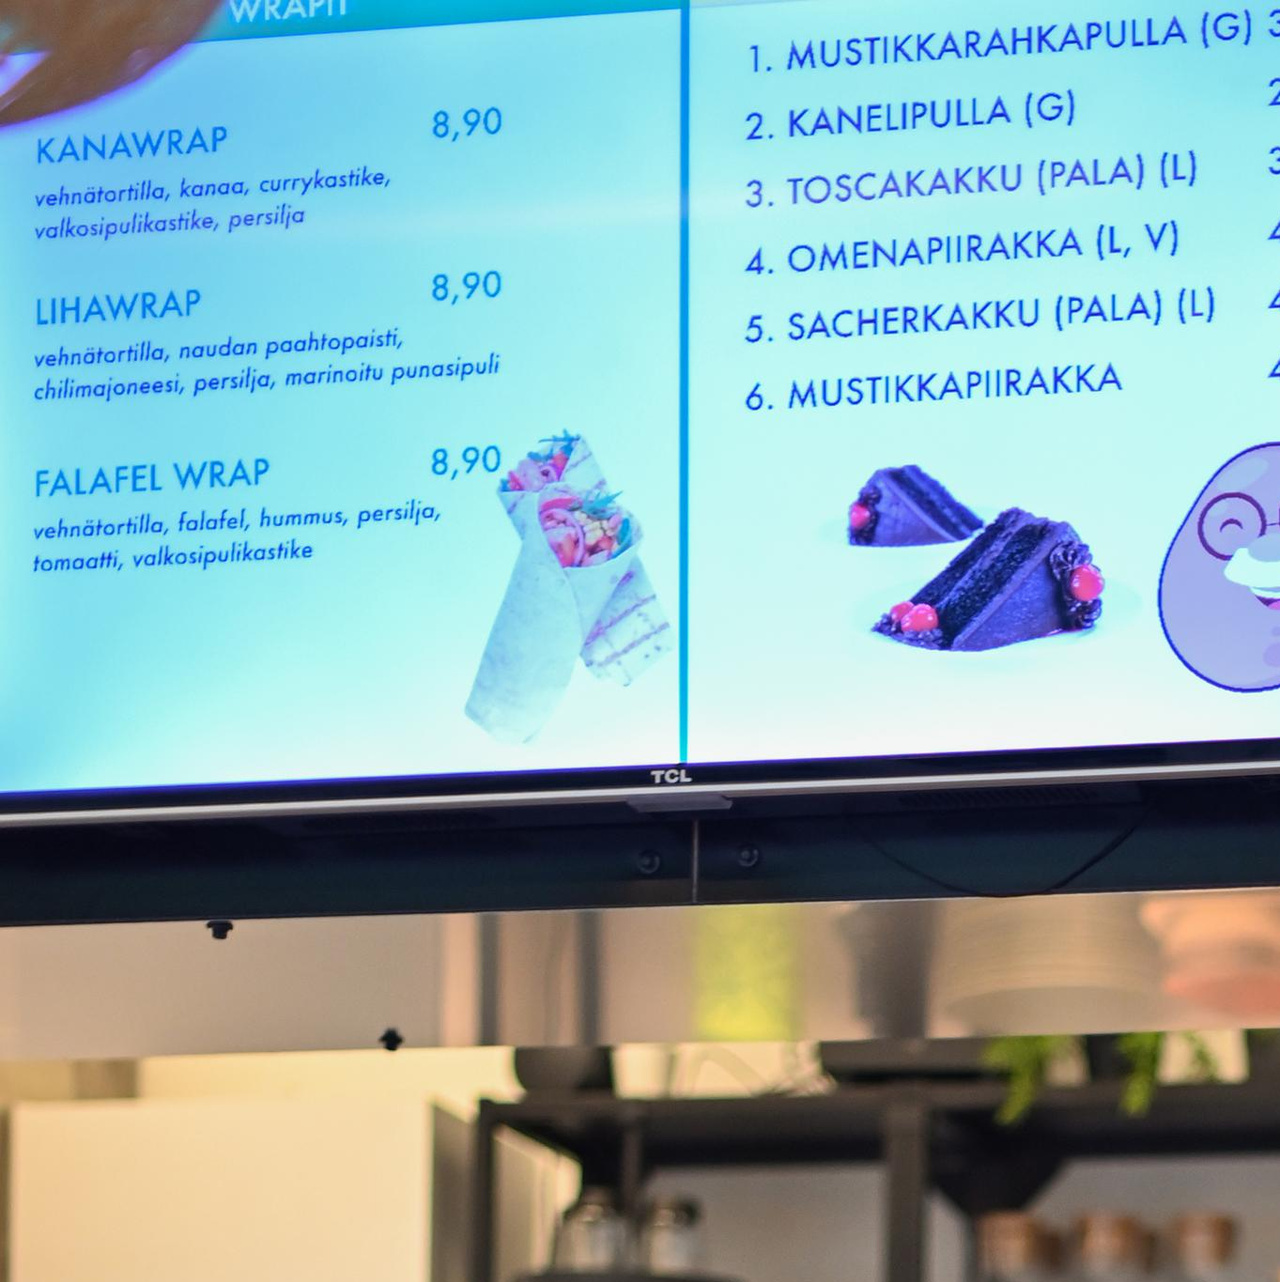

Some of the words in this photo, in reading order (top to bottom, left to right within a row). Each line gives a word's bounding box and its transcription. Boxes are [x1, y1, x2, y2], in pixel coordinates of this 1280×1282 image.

[749, 45, 773, 73] 1.
[786, 15, 1189, 71] MUSTIKKARAHKAPULLA
[1200, 9, 1258, 49] (G)
[431, 105, 504, 143] 8,90
[745, 112, 775, 141] 2.
[788, 95, 1012, 137] KANELIPULLA
[1025, 88, 1076, 129] (G)
[36, 126, 229, 166] KANAWRAP
[35, 179, 171, 208] vehnätortilla,
[180, 177, 250, 198] kanaa,
[257, 165, 391, 196] currykastike,
[745, 179, 775, 208] 3.
[786, 163, 1022, 205] TOSCAKAKKU
[1038, 152, 1145, 196] (PALA)
[1160, 150, 1198, 189] (L)
[35, 208, 219, 241] valkosipulikastike,
[228, 203, 305, 233] persilja
[743, 244, 776, 275] 4.
[787, 226, 1084, 273] OMENAPIIRAKKA
[1096, 224, 1132, 261] (L,
[1143, 219, 1180, 257] V)
[36, 288, 202, 327] LIHAWRAP
[431, 269, 504, 306] 8,90
[744, 314, 776, 345] 5.
[787, 297, 1041, 341] SACHERKAKKU
[1054, 288, 1164, 332] (PALA)
[1177, 285, 1216, 325] (L)
[34, 340, 170, 368] vehnätortilla,
[179, 335, 259, 360] naudan
[264, 327, 404, 360] paahtopaisti,
[34, 372, 185, 402] chilimajoneesi,
[192, 366, 277, 398] persilja,
[285, 362, 385, 387] marinoitu
[390, 351, 501, 386] punasipuli
[744, 380, 776, 412] 6.
[787, 361, 1124, 410] MUSTIKKAPIIRAKKA
[35, 462, 164, 498] FALAFEL
[172, 456, 271, 491] WRAP
[431, 443, 502, 481] 8,90
[33, 512, 169, 541] vehnätortilla,
[178, 507, 250, 534] falafel,
[258, 506, 350, 528] hummus,
[356, 497, 443, 530] persilja,
[33, 549, 124, 573] tomaatti,
[132, 537, 315, 571] valkosipulikastike
[651, 769, 693, 784] TCL
